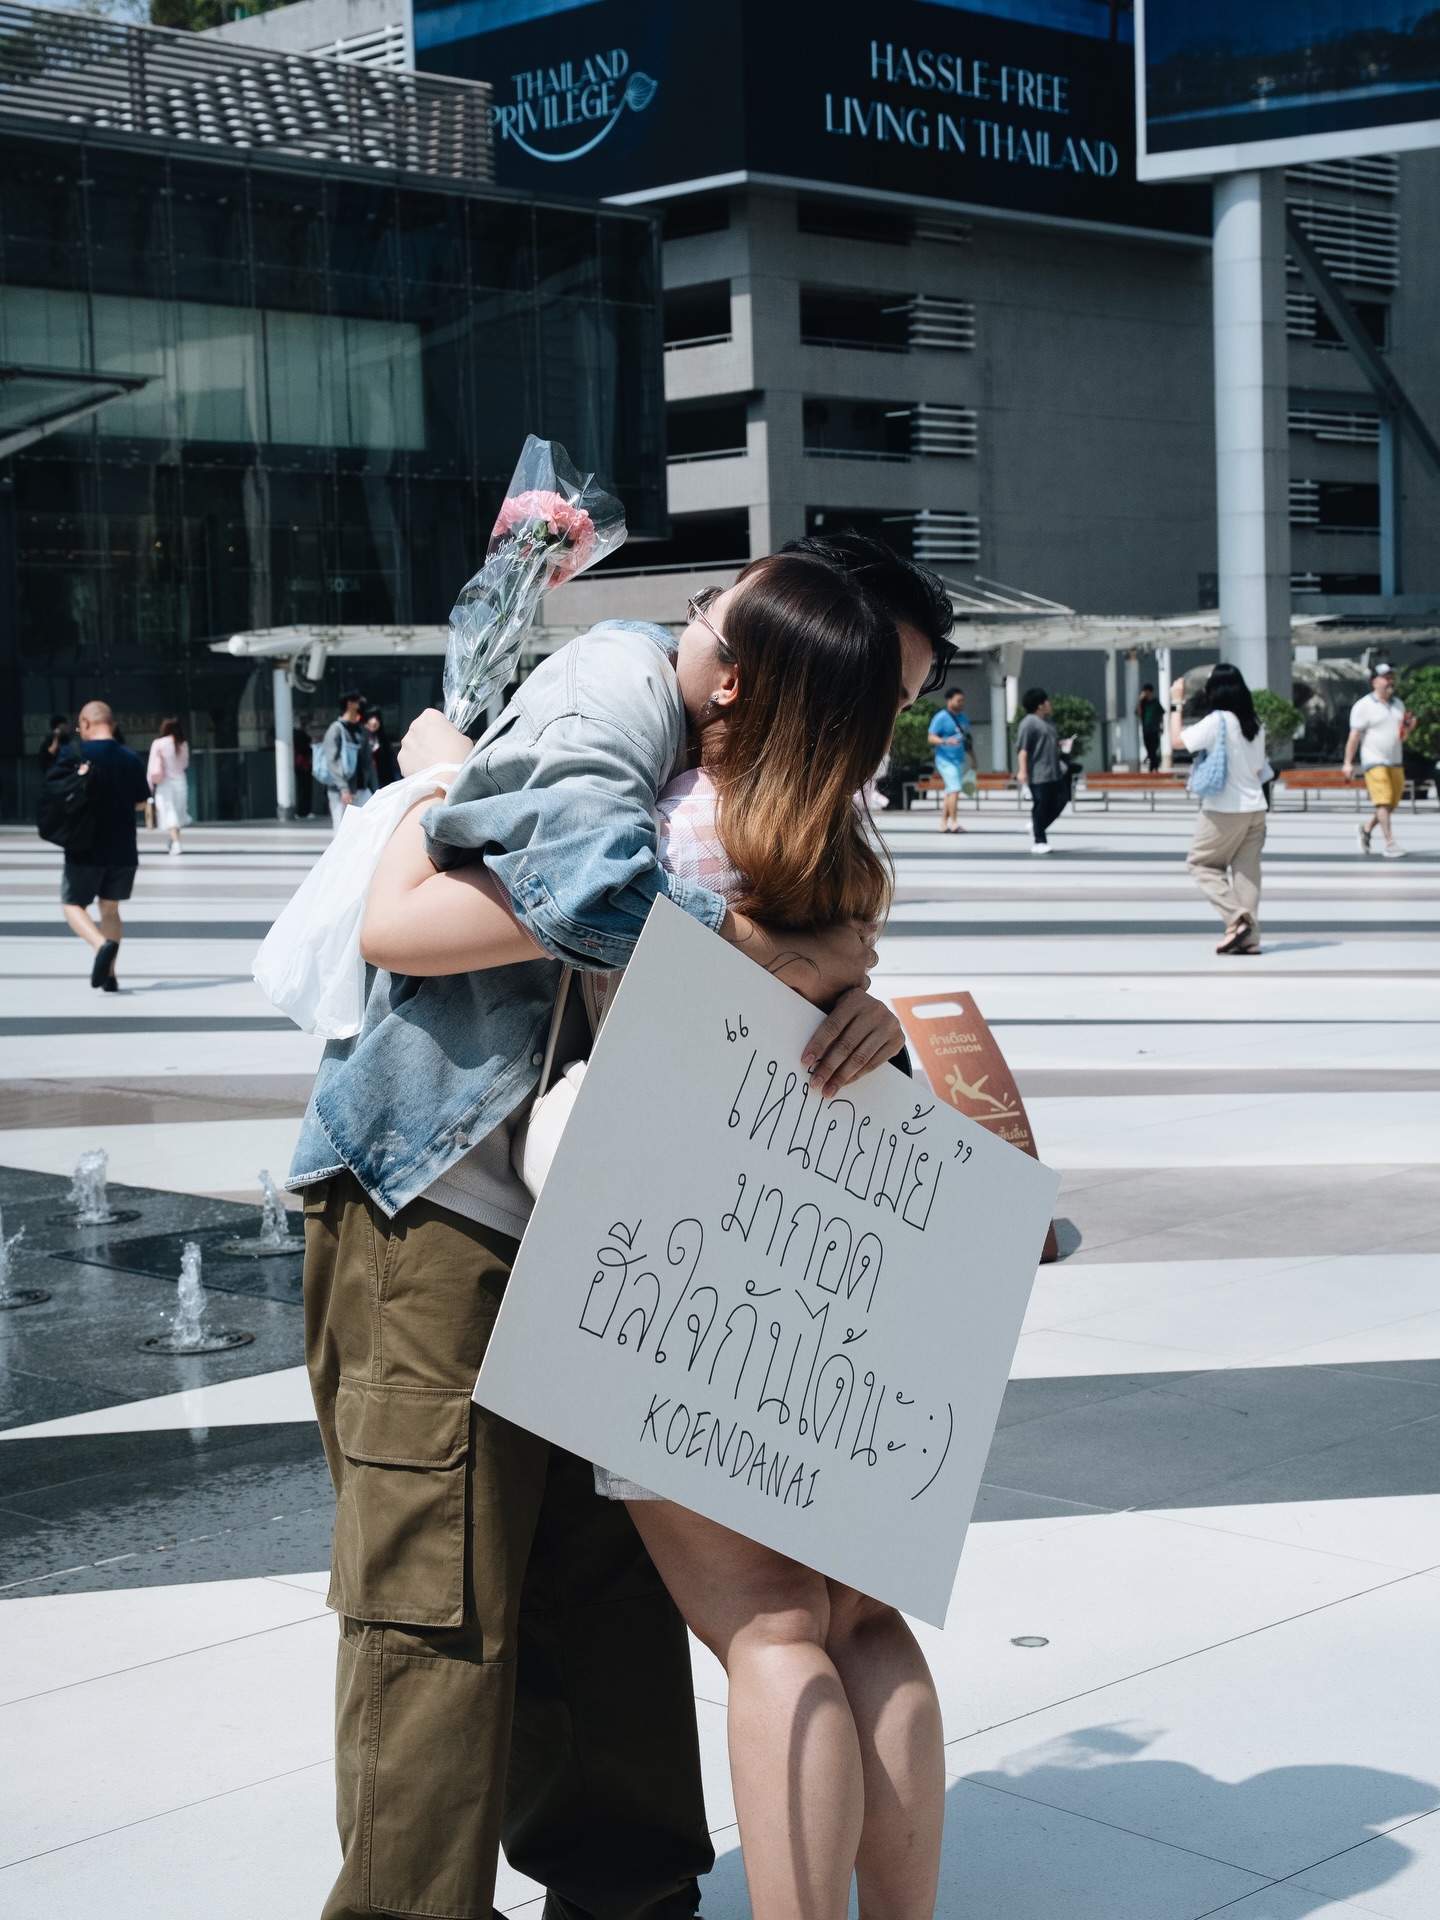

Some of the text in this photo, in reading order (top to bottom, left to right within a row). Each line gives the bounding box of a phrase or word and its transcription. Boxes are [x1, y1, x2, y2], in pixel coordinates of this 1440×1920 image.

[487, 80, 617, 143] PRIVILEGE
[511, 48, 629, 101] THAILAND
[870, 39, 1070, 115] HASSLE-FREE
[825, 92, 1119, 178] LIVING IN THAILAND
[934, 1043, 983, 1057] CAUTION
[721, 1173, 884, 1313] มากอด
[639, 1393, 821, 1509] KOENDANAI
